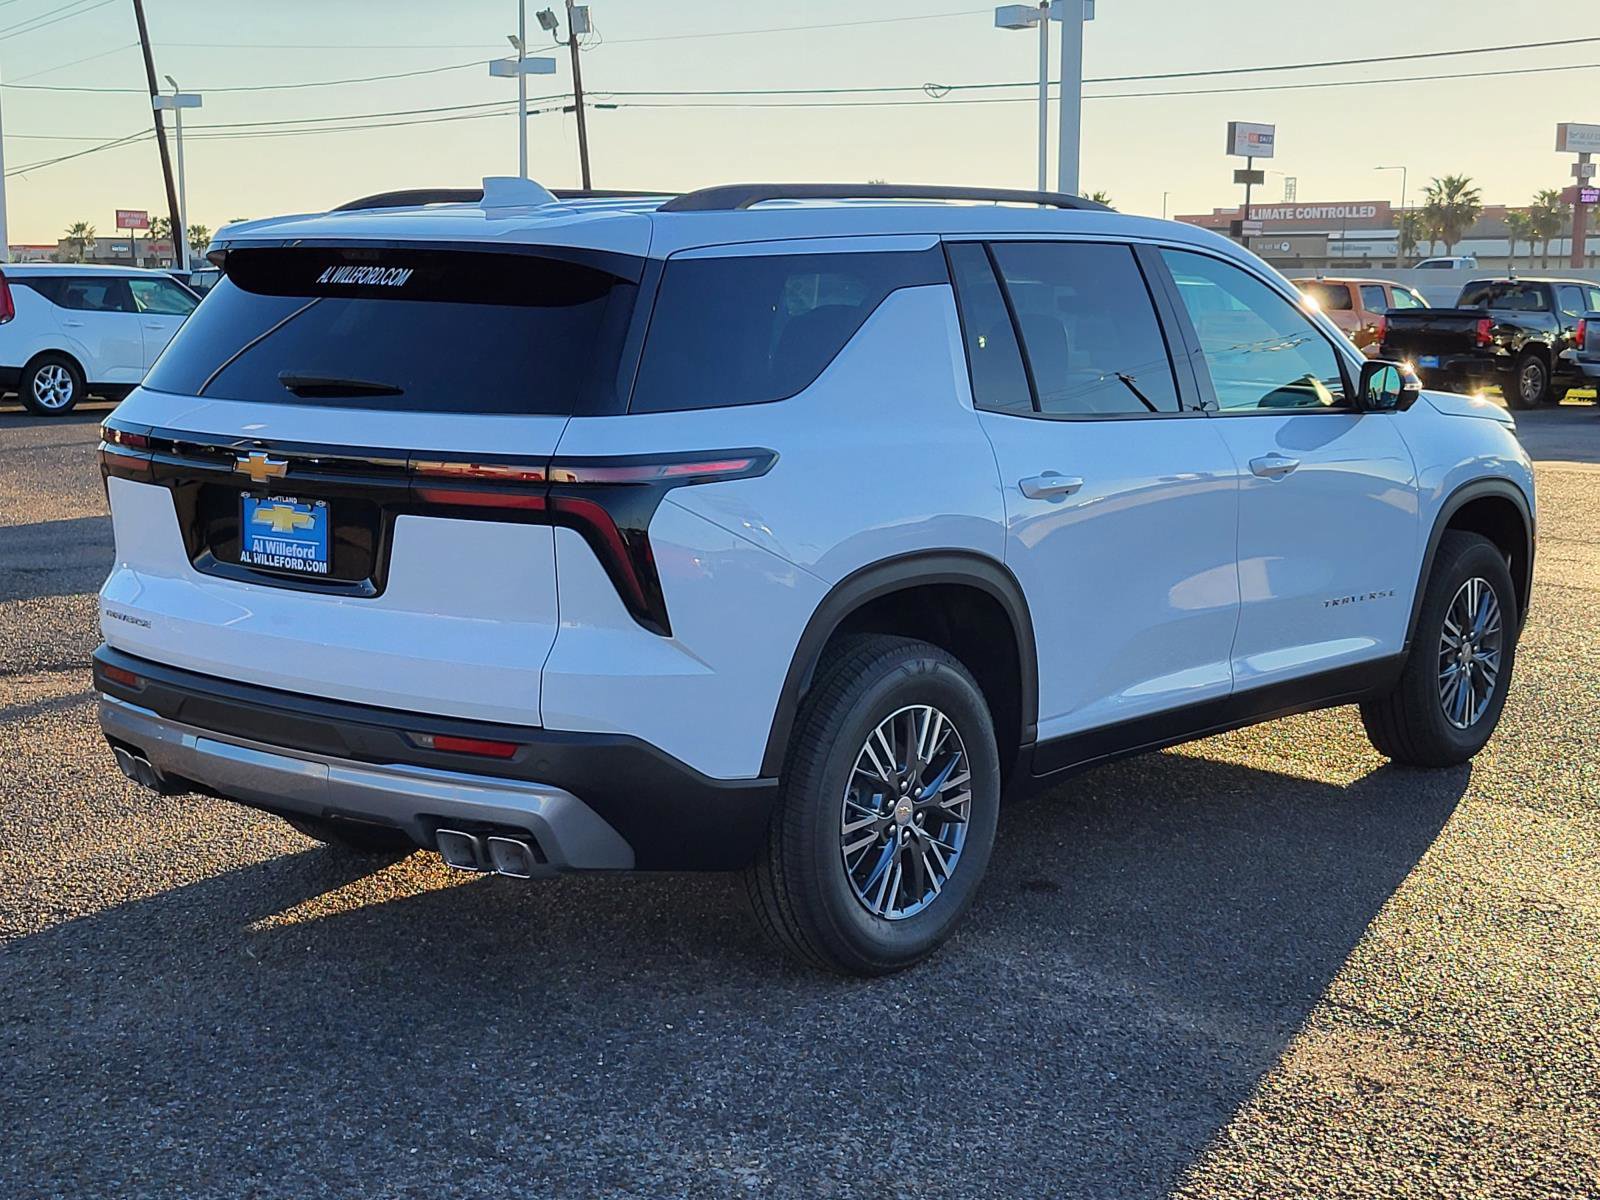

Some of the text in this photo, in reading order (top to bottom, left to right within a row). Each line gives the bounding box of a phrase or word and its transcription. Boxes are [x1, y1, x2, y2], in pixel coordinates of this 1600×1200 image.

[1296, 206, 1376, 219] CONTROLLED
[330, 266, 414, 286] WILLEFORD.COM
[252, 539, 316, 559] Al Willeford
[240, 550, 328, 574] AL WILLEFORD.COM
